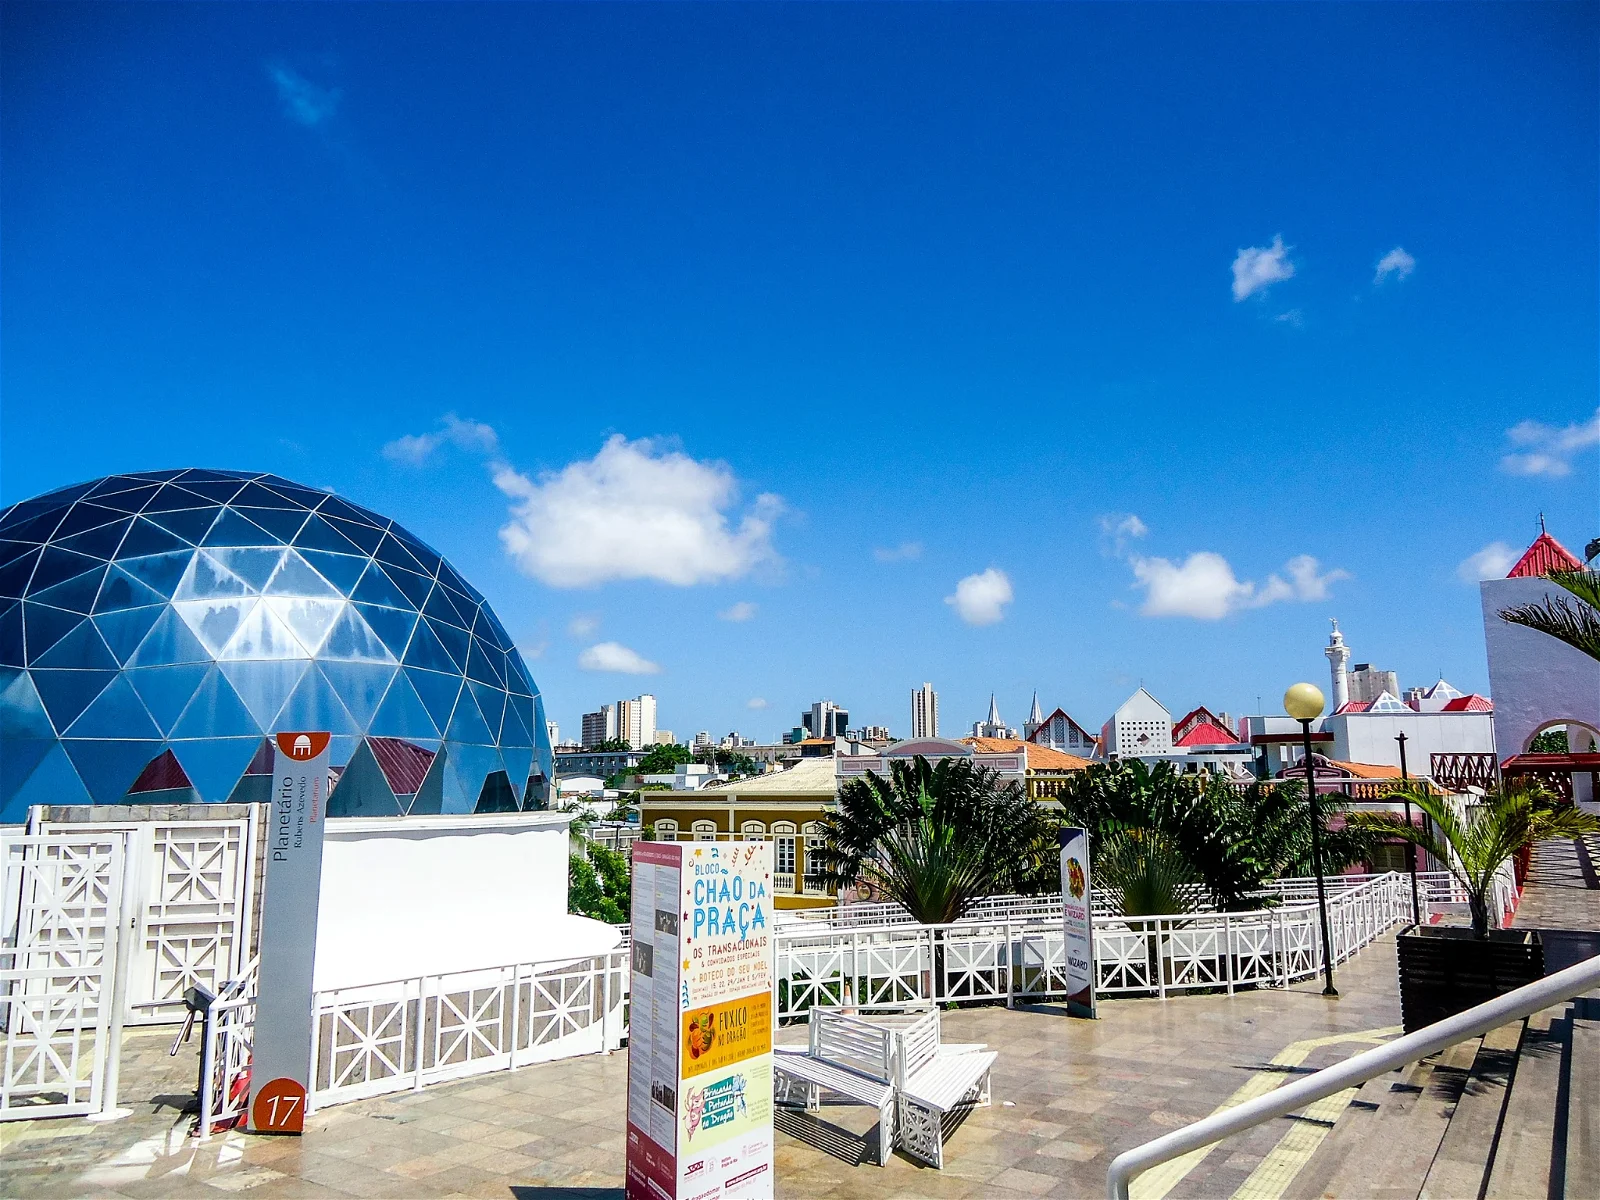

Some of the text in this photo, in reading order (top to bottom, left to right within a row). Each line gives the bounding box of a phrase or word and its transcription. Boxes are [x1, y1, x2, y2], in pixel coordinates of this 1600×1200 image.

[309, 776, 319, 824] Planetarium
[273, 776, 293, 861] Planetário
[294, 776, 306, 848] Rubens Azevedo
[695, 863, 719, 876] BLOCO
[694, 869, 765, 906] CHÃO DA
[693, 902, 765, 941] PRAÇA
[1068, 909, 1085, 921] WIZARD
[693, 936, 767, 959] OS TRANSACIONAIS
[707, 955, 735, 967] CONVIDADOS
[737, 950, 760, 961] ESPECIAIS
[699, 969, 723, 983] BOTECO
[727, 967, 735, 977] DO
[739, 964, 750, 974] SEU
[754, 960, 767, 971] NOEL
[1067, 955, 1088, 971] WIZARD
[719, 1006, 747, 1032] FUXICO
[718, 1027, 747, 1047] NO DRAGÃO
[703, 1081, 732, 1099] Brincando
[267, 1095, 301, 1126] 17
[708, 1094, 733, 1112] Pintando
[711, 1109, 734, 1124] Dragão
